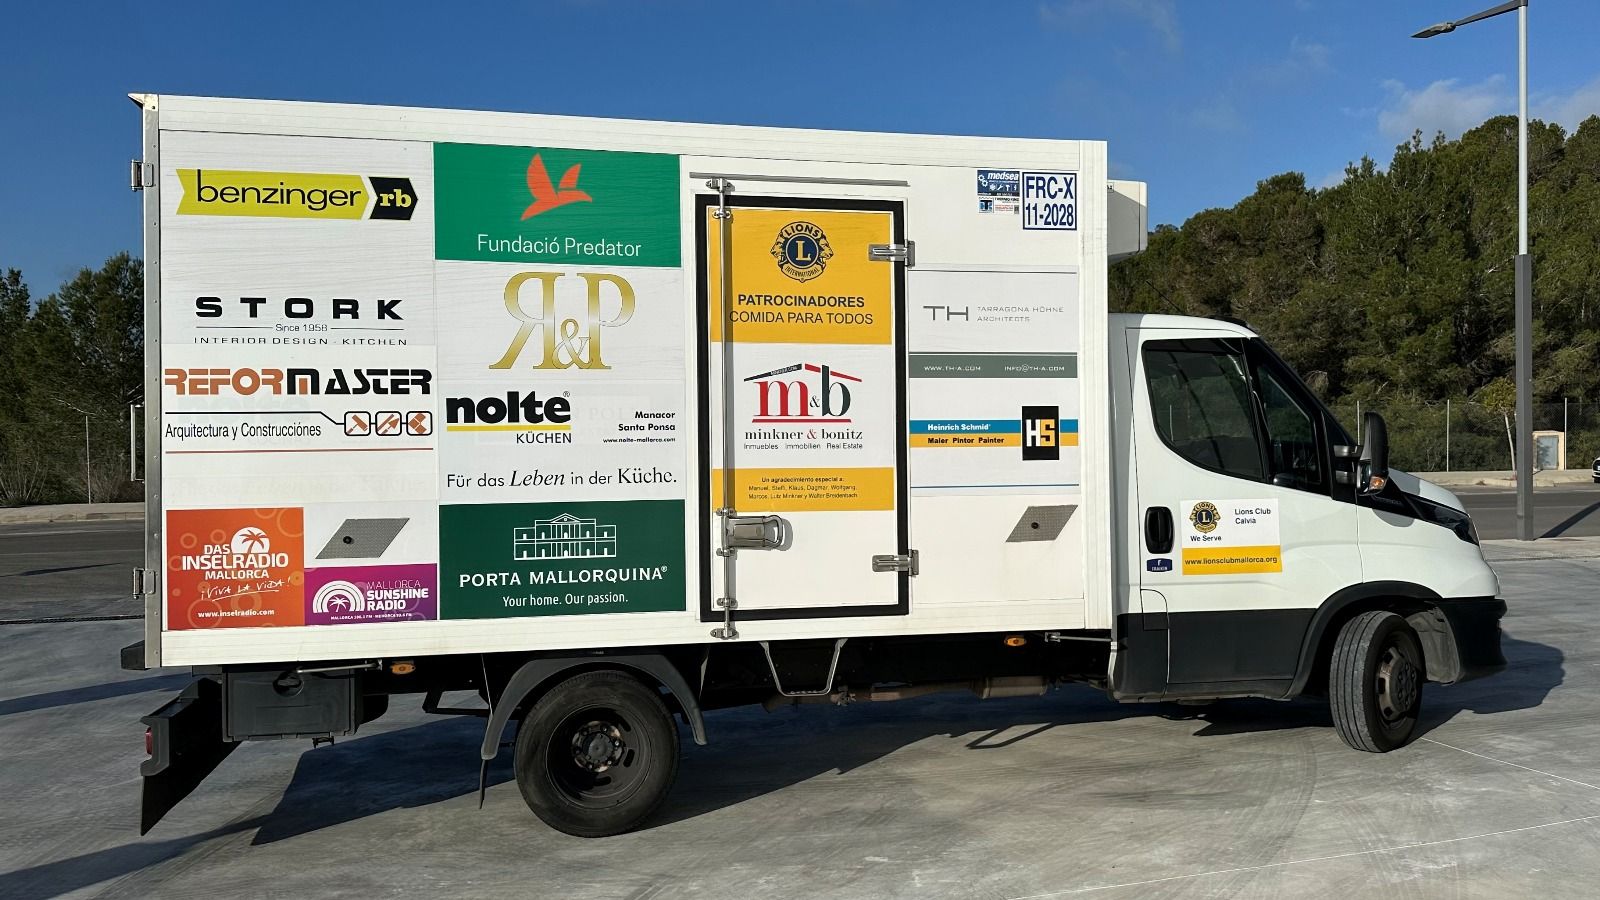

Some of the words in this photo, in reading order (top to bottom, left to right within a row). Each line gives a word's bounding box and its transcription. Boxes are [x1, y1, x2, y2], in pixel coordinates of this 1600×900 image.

[988, 172, 1019, 180] medsea
[197, 169, 361, 211] benzinger
[1026, 176, 1073, 199] FRC-X
[380, 189, 412, 207] rb
[1026, 203, 1073, 226] 11-2028
[784, 224, 820, 238] LIONS
[477, 234, 559, 254] Fundació
[565, 237, 641, 257] Predator
[796, 240, 811, 261] L
[785, 266, 820, 278] INTERNATIONAL
[738, 295, 864, 307] PATROCINADORES
[196, 297, 404, 320] STORK
[923, 306, 968, 321] TH
[730, 311, 784, 323] COMIDA
[788, 312, 823, 323] PARA
[827, 313, 873, 324] TODOS
[276, 324, 300, 333] Since
[165, 368, 432, 395] REFORMASTER
[634, 411, 675, 419] Manacor
[165, 424, 229, 441] Arquitectura
[232, 427, 237, 440] y
[241, 422, 321, 436] Construcciónes
[516, 431, 572, 444] KÜCHEN
[745, 429, 803, 440] minkner
[807, 430, 816, 440] &
[822, 429, 862, 440] bonitz
[1026, 419, 1055, 447] HS
[447, 474, 471, 487] Für
[478, 473, 504, 487] das
[509, 470, 564, 487] Leben
[571, 472, 583, 484] in
[589, 471, 612, 484] der
[617, 467, 677, 484] Küche.
[1202, 512, 1210, 522] L
[204, 544, 230, 555] DAS
[182, 553, 288, 570] INSELRADIO
[205, 570, 269, 580] MALLORCA
[459, 573, 521, 587] PORTA
[367, 580, 420, 590] MALLORCA
[367, 589, 429, 600] SUNSHINE
[503, 596, 527, 607] Your
[530, 594, 561, 606] home.
[566, 594, 584, 604] Our
[588, 592, 628, 605] passion.
[367, 600, 406, 610] RADIO
[198, 609, 274, 618] www.inselradio.com
